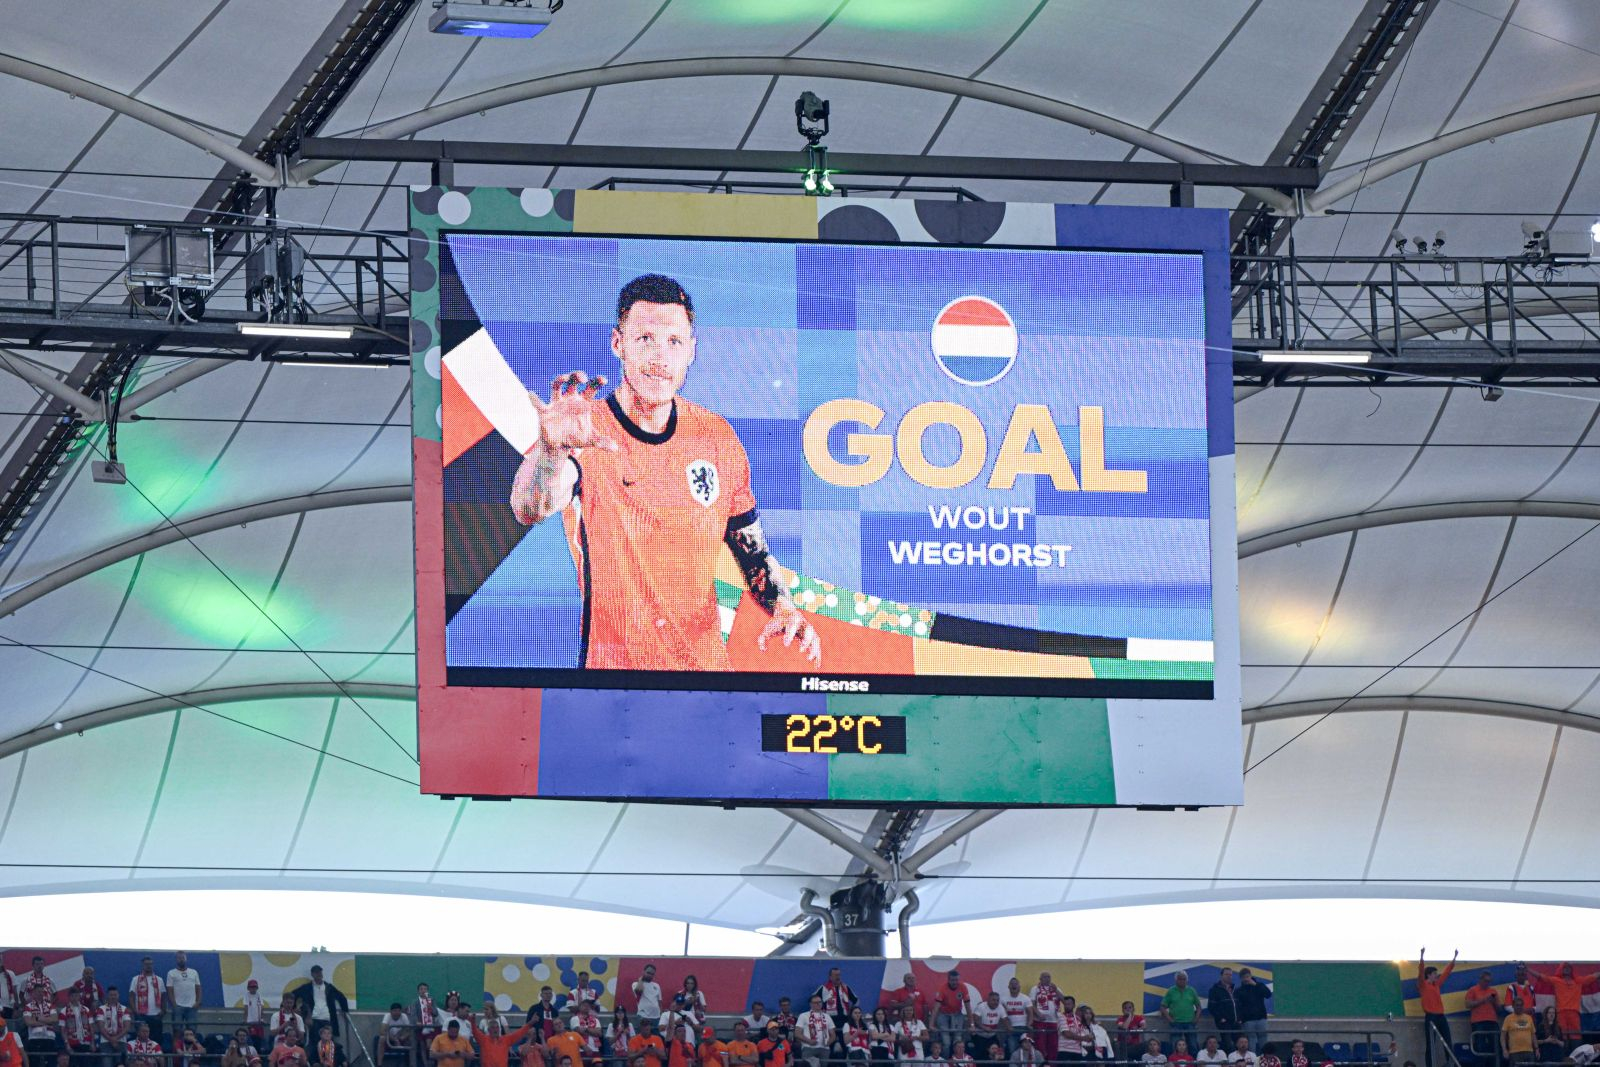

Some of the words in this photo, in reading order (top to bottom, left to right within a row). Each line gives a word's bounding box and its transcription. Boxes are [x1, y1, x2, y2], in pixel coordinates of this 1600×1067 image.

[803, 398, 1149, 493] GOAL
[928, 505, 1031, 530] WOUT
[888, 541, 1073, 568] WEGHORST
[800, 676, 870, 692] Hisense
[786, 715, 883, 755] 22°C
[845, 914, 858, 926] 37
